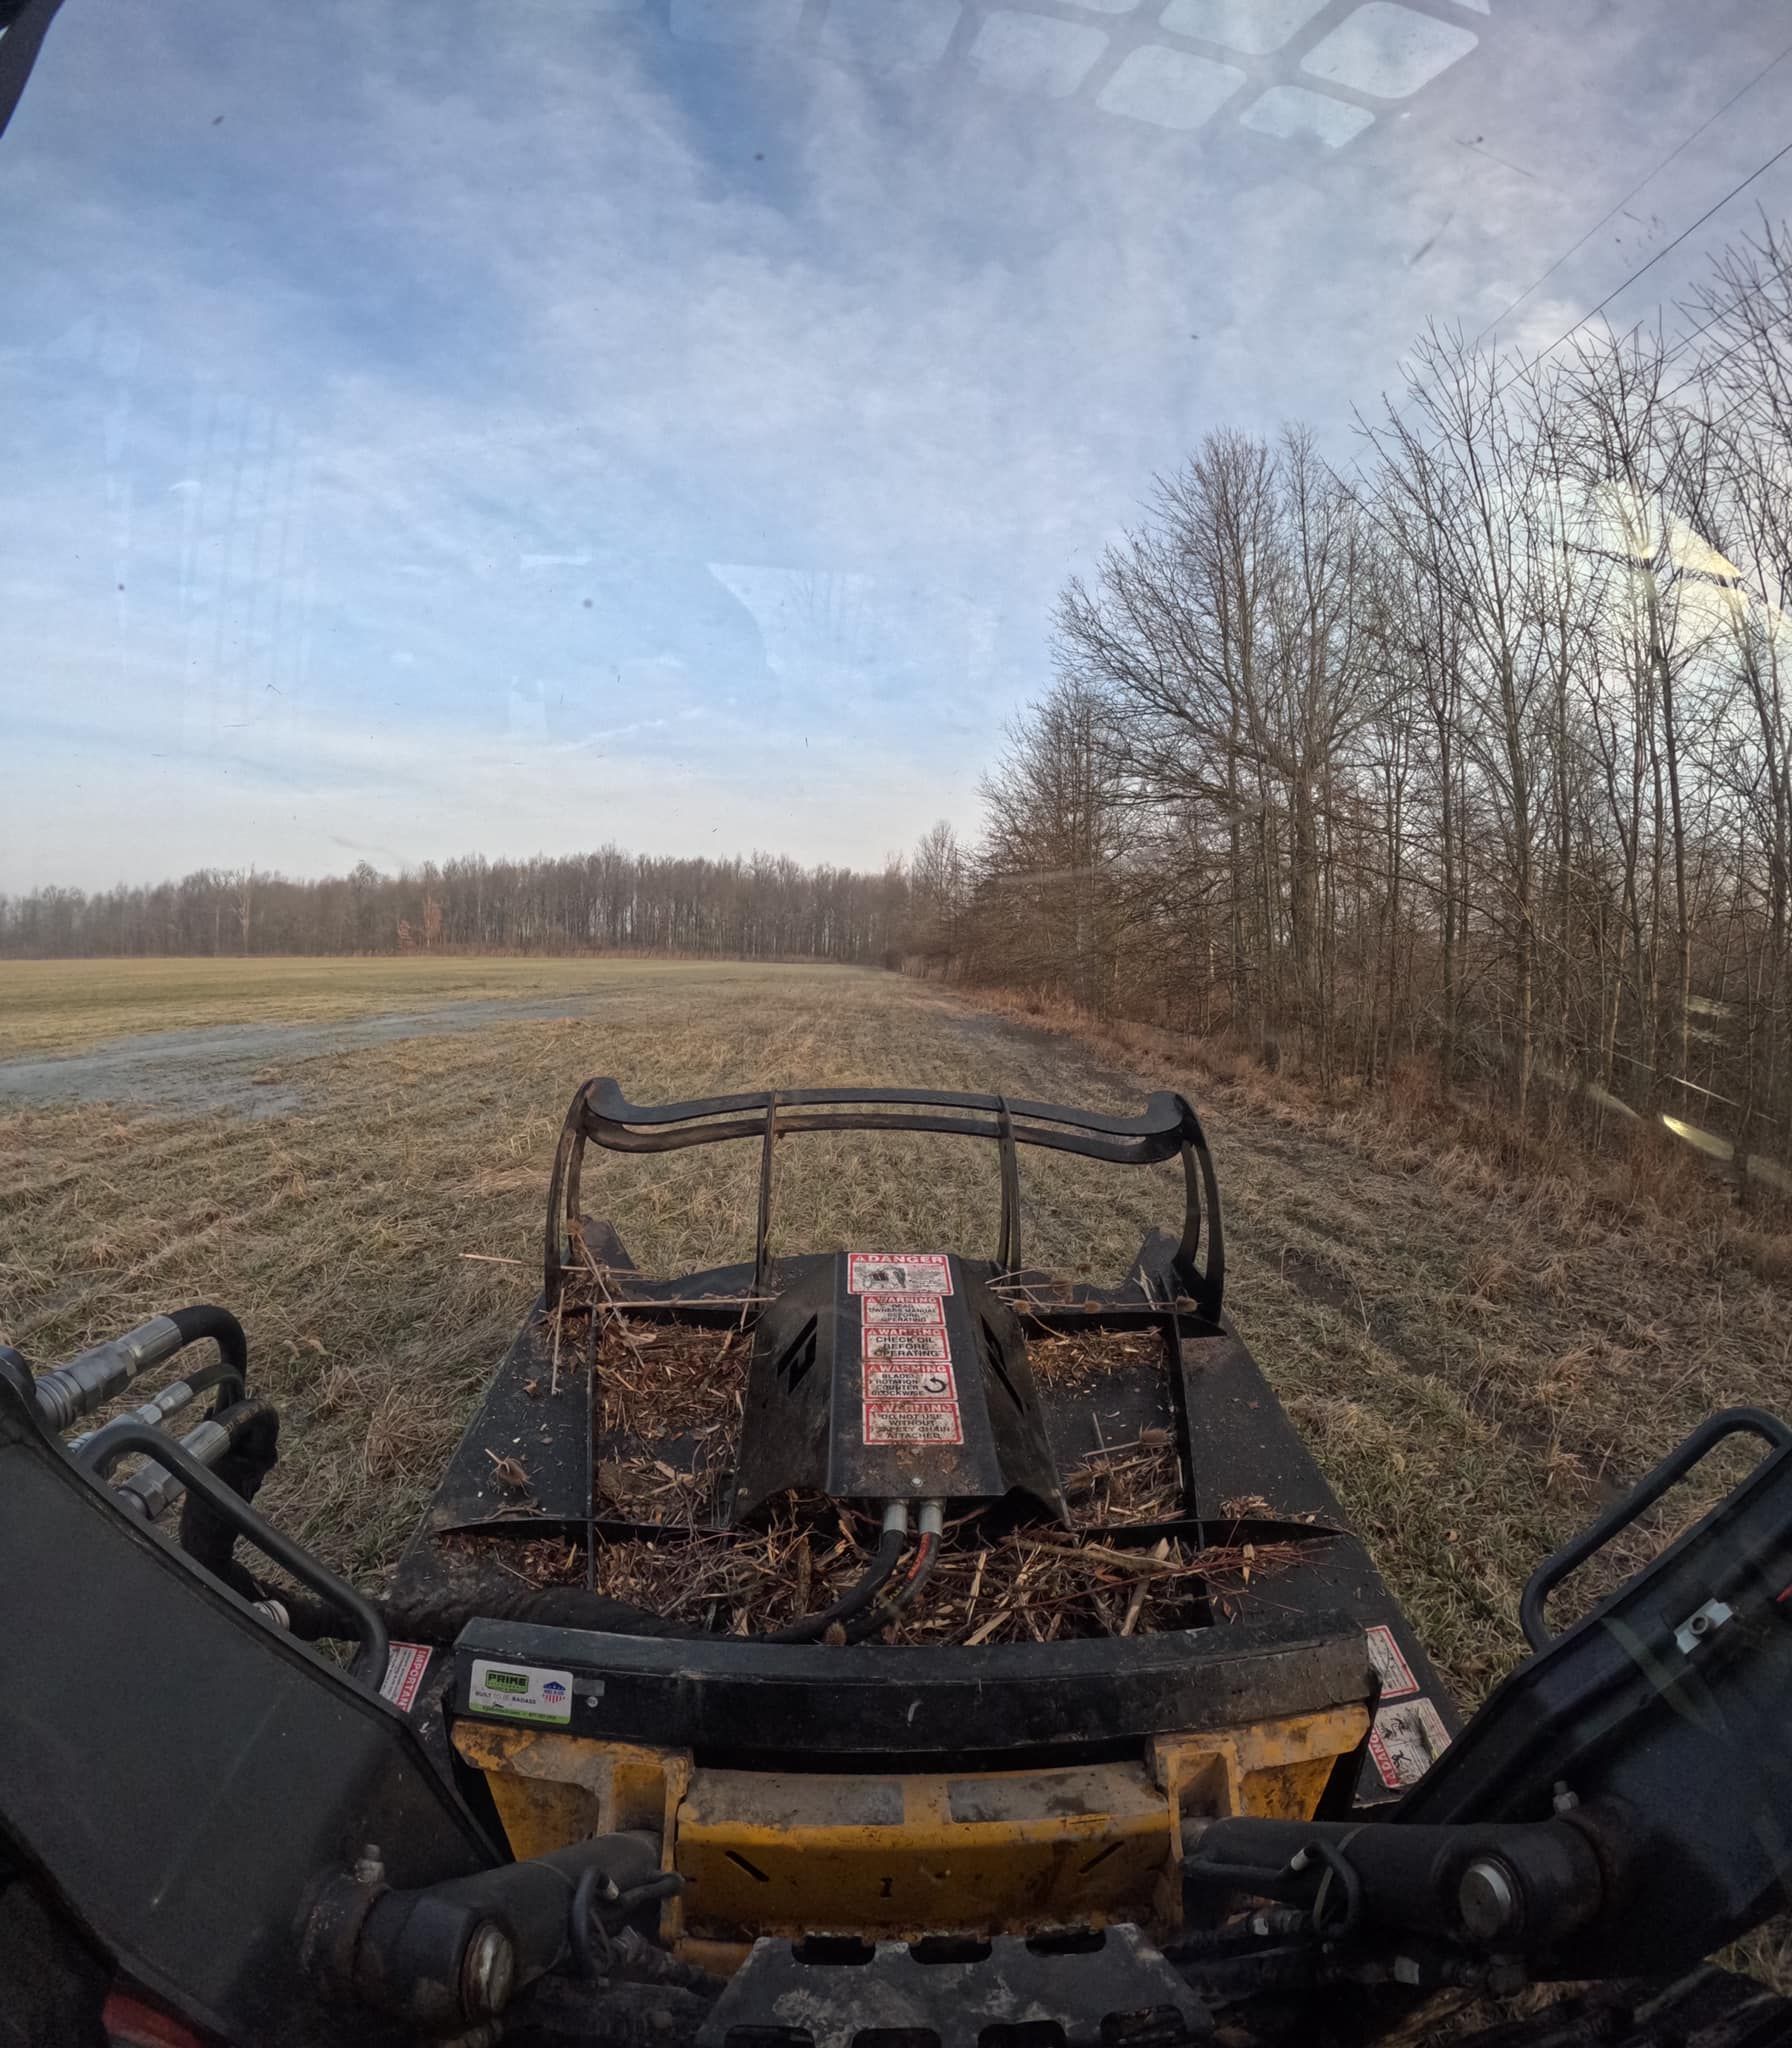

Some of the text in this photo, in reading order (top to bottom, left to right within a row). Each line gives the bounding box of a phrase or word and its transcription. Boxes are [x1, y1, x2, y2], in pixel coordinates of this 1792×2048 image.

[868, 1255, 944, 1263] DANGER
[879, 1365, 946, 1373] WARNING
[488, 1673, 528, 1687] PRIME
[1370, 1728, 1392, 1771] DANG
